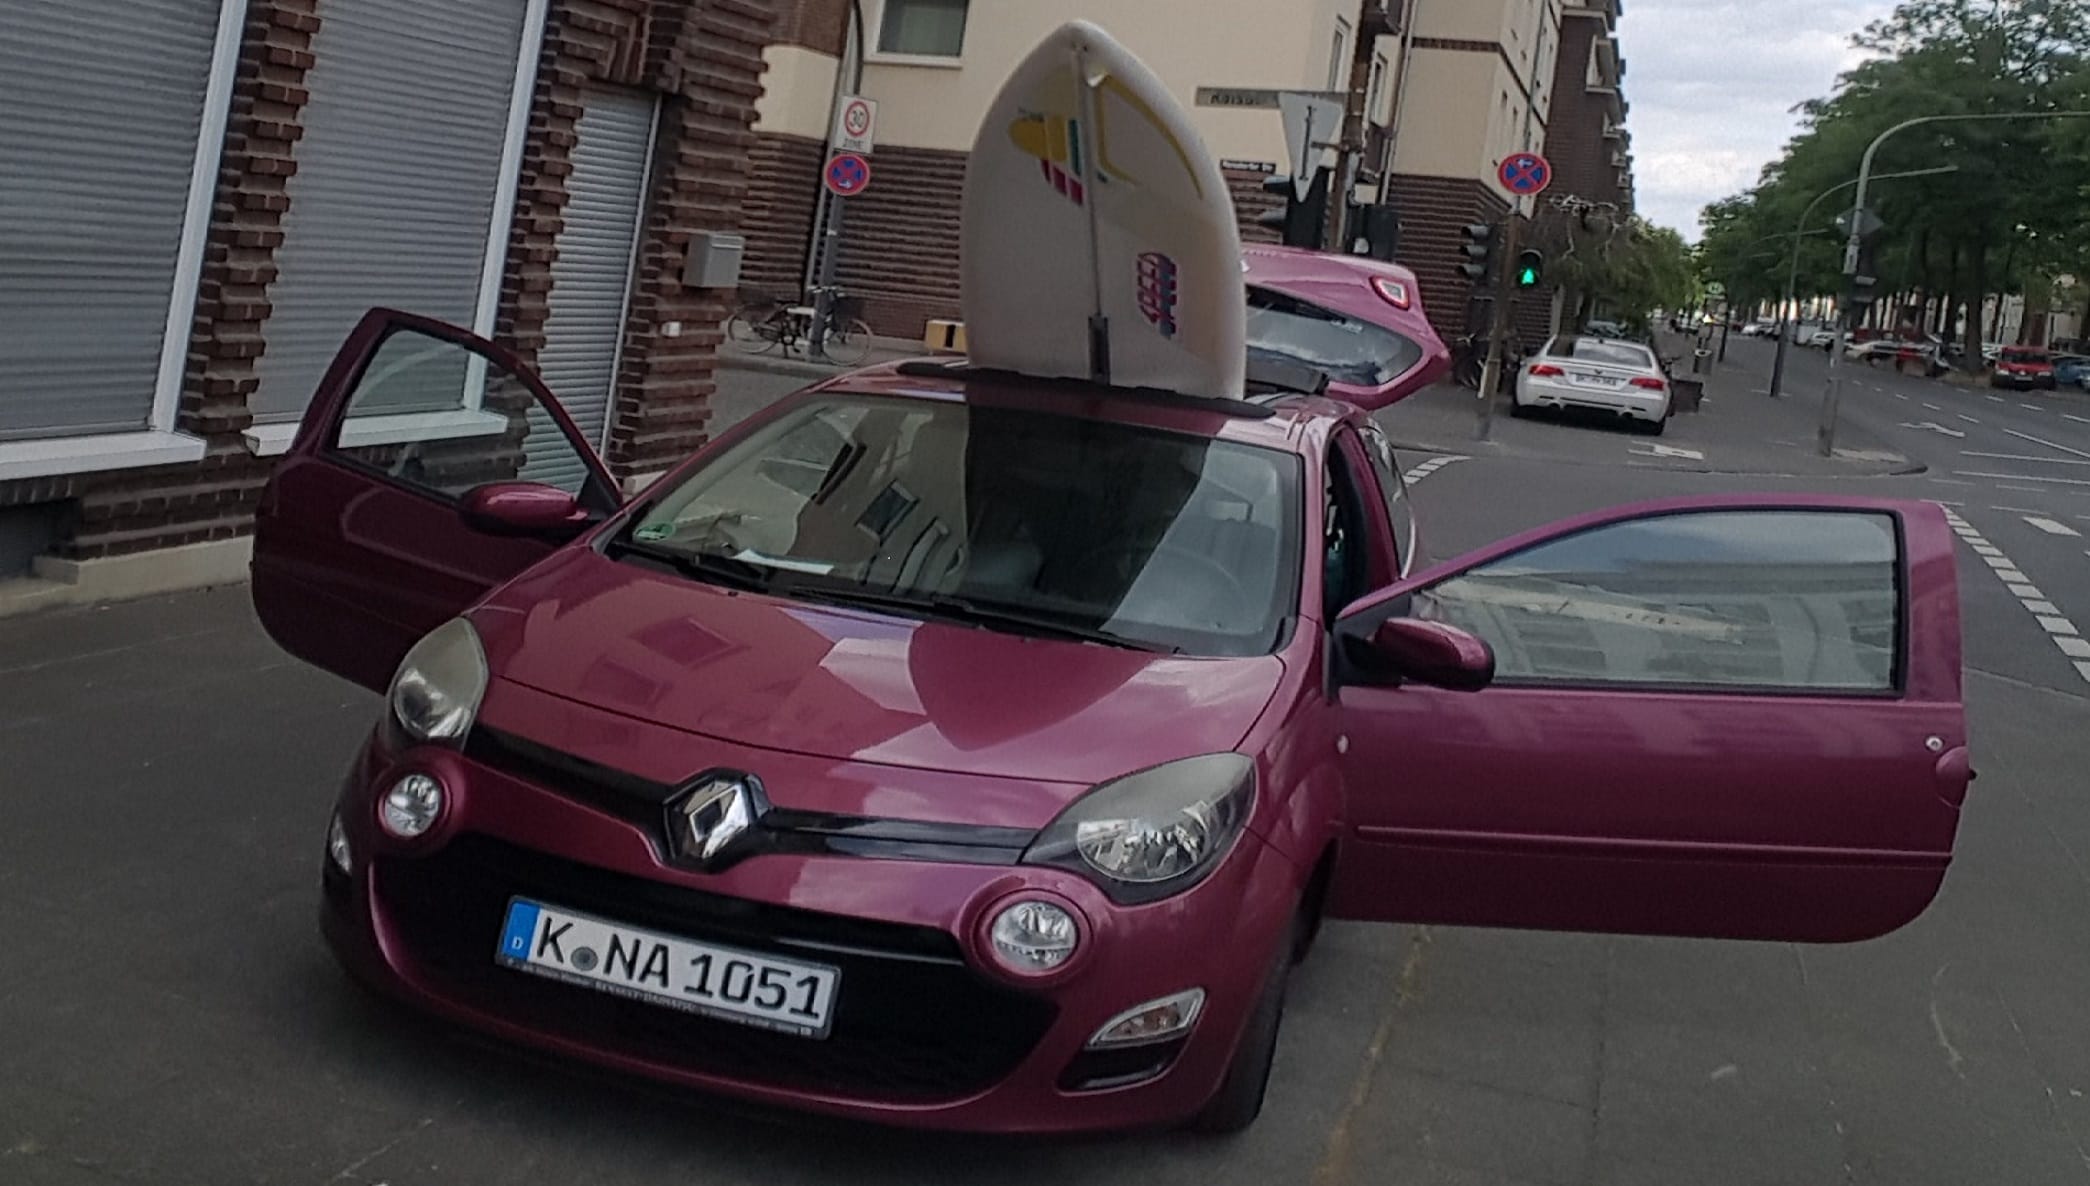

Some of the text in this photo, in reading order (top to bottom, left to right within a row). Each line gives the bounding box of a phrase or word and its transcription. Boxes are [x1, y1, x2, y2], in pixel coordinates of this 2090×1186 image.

[850, 109, 864, 129] 30
[511, 936, 523, 949] D
[537, 917, 573, 964] K
[603, 933, 671, 988] NA
[683, 954, 821, 1020] 1051
